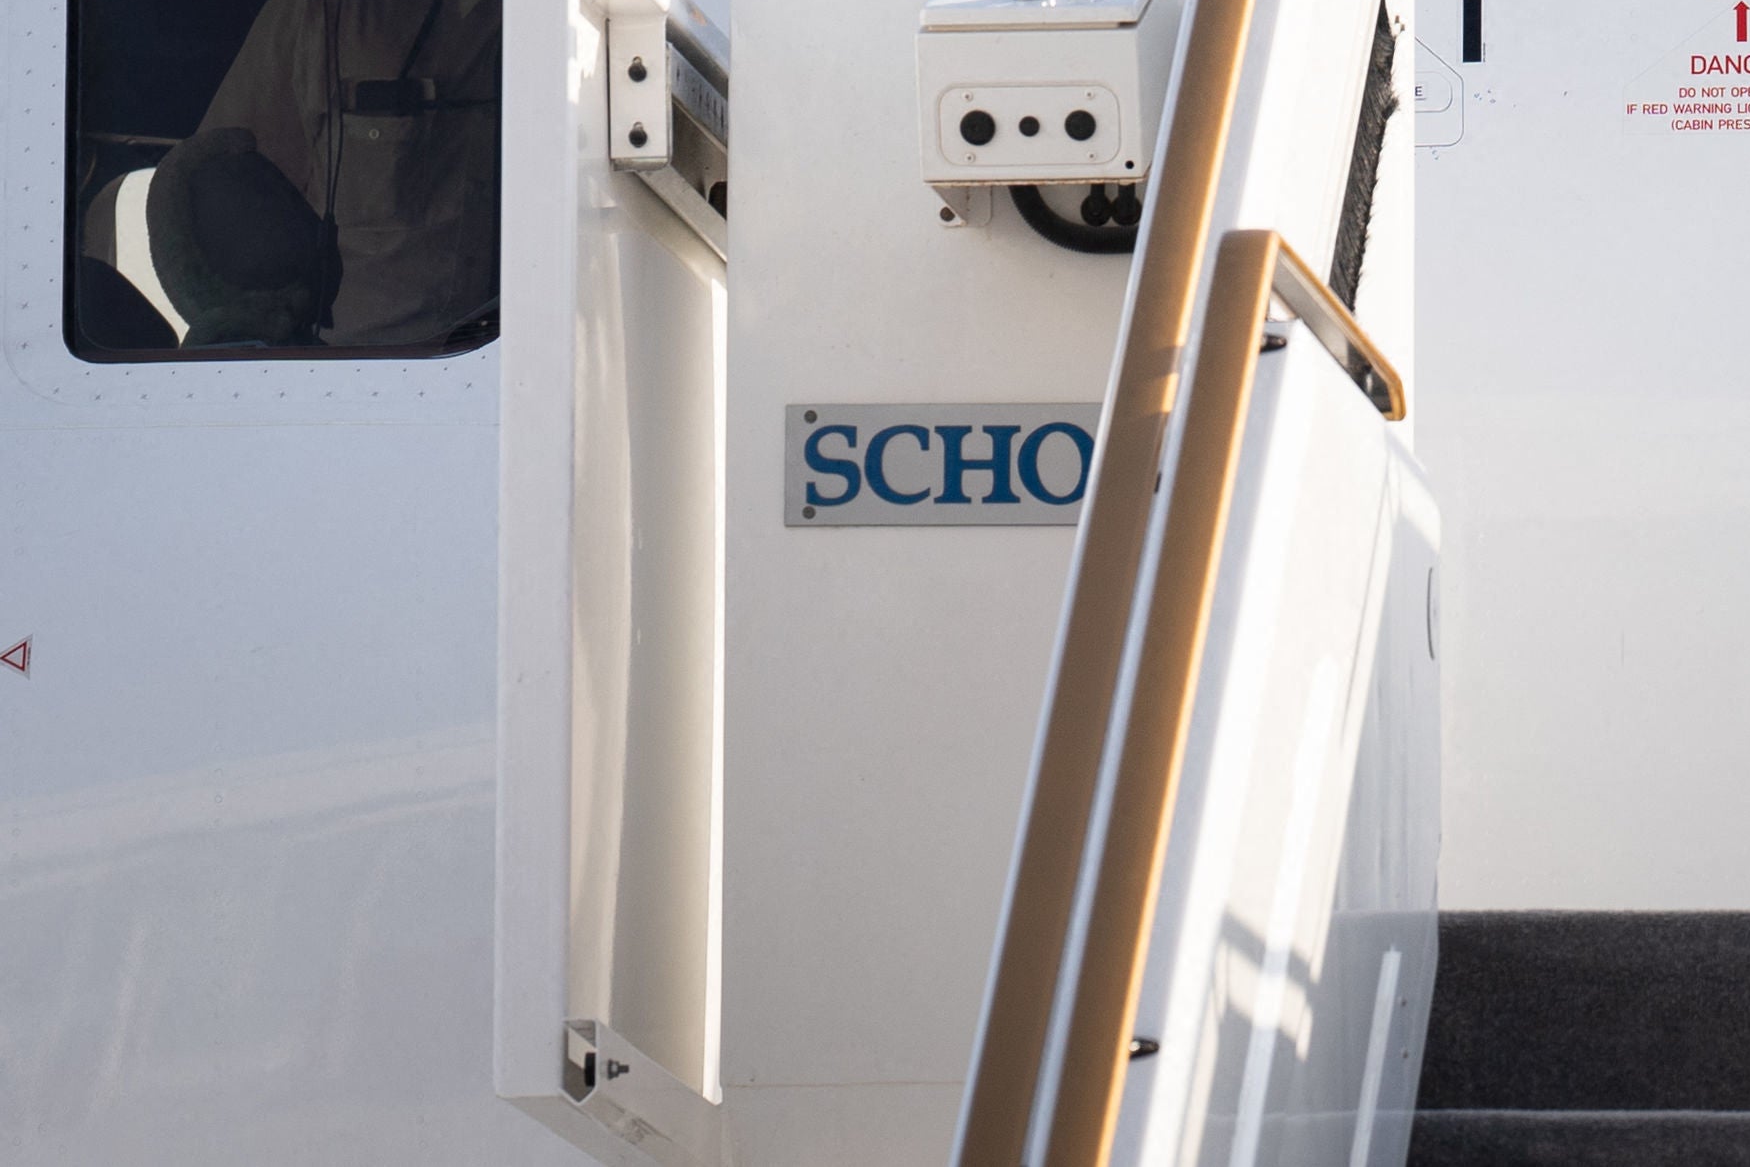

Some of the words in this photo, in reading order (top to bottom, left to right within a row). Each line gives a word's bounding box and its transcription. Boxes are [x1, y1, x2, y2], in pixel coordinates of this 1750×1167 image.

[1678, 87, 1697, 99] DO
[1700, 86, 1726, 98] NOT
[1626, 103, 1637, 115] IF
[1642, 103, 1668, 115] RED
[1672, 102, 1733, 115] WARNING
[1670, 118, 1714, 131] (CABIN
